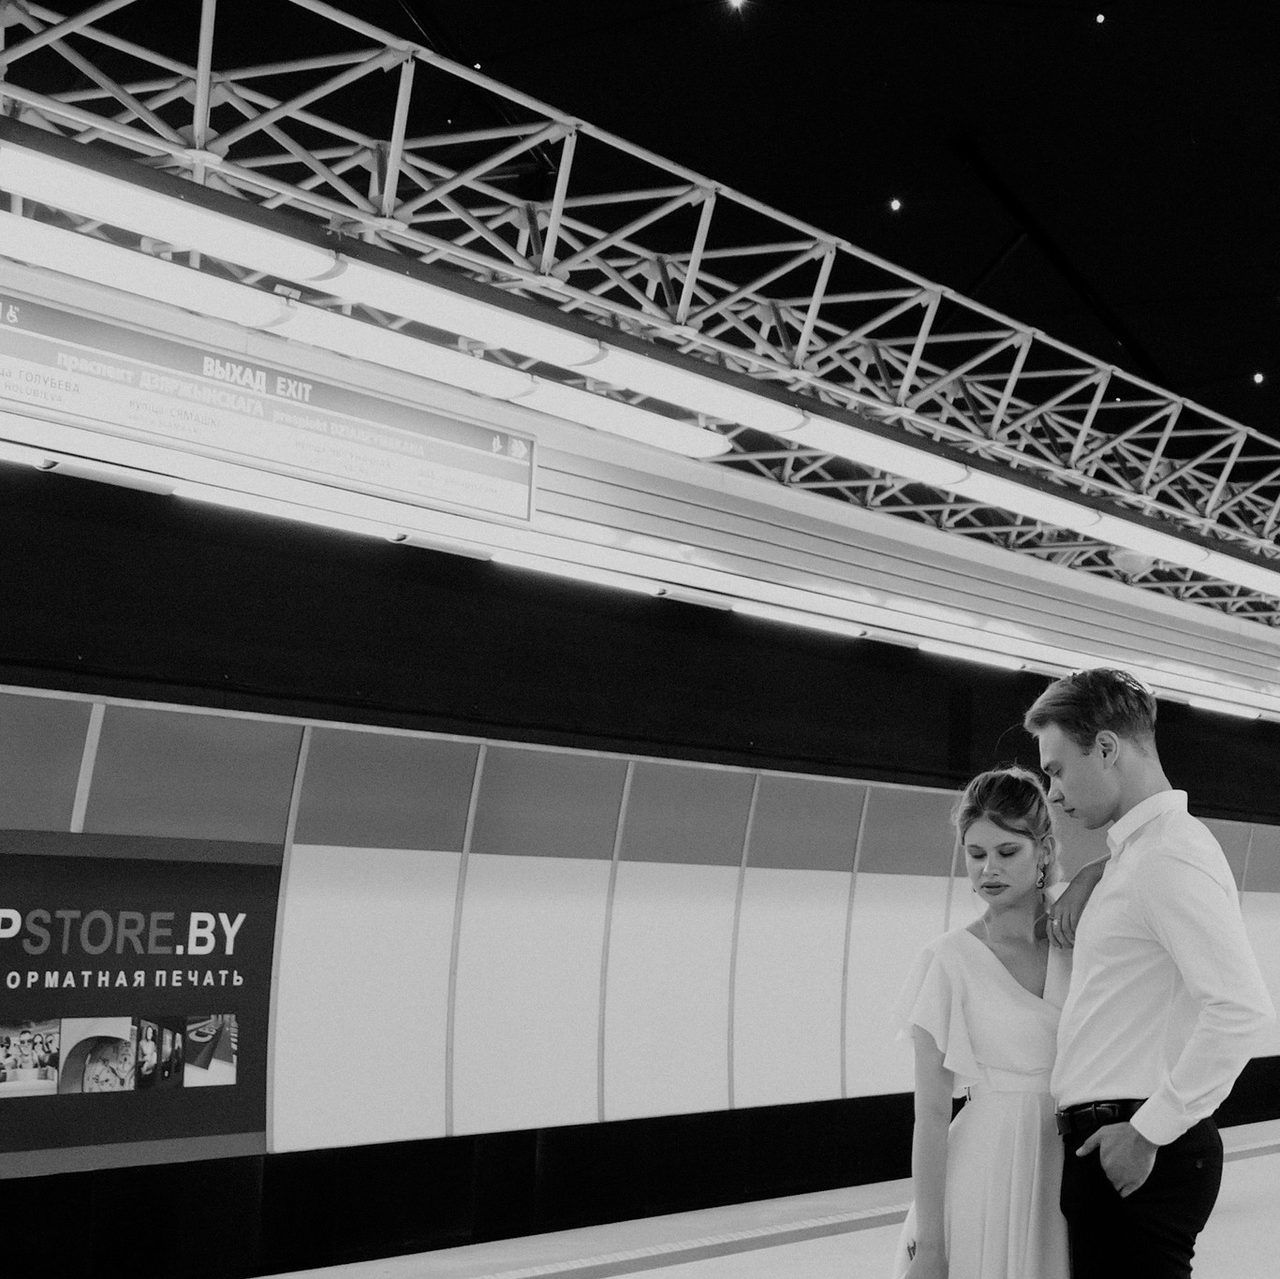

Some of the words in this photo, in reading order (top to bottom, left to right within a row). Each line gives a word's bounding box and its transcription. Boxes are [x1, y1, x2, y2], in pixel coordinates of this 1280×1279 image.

[18, 370, 80, 393] ГОЛУБЕВА
[202, 356, 266, 394] ВЫХАД
[275, 376, 312, 402] EXIT
[6, 970, 146, 989] ОРМАТНАЯ
[155, 970, 244, 987] ПЕЧАТЬ
